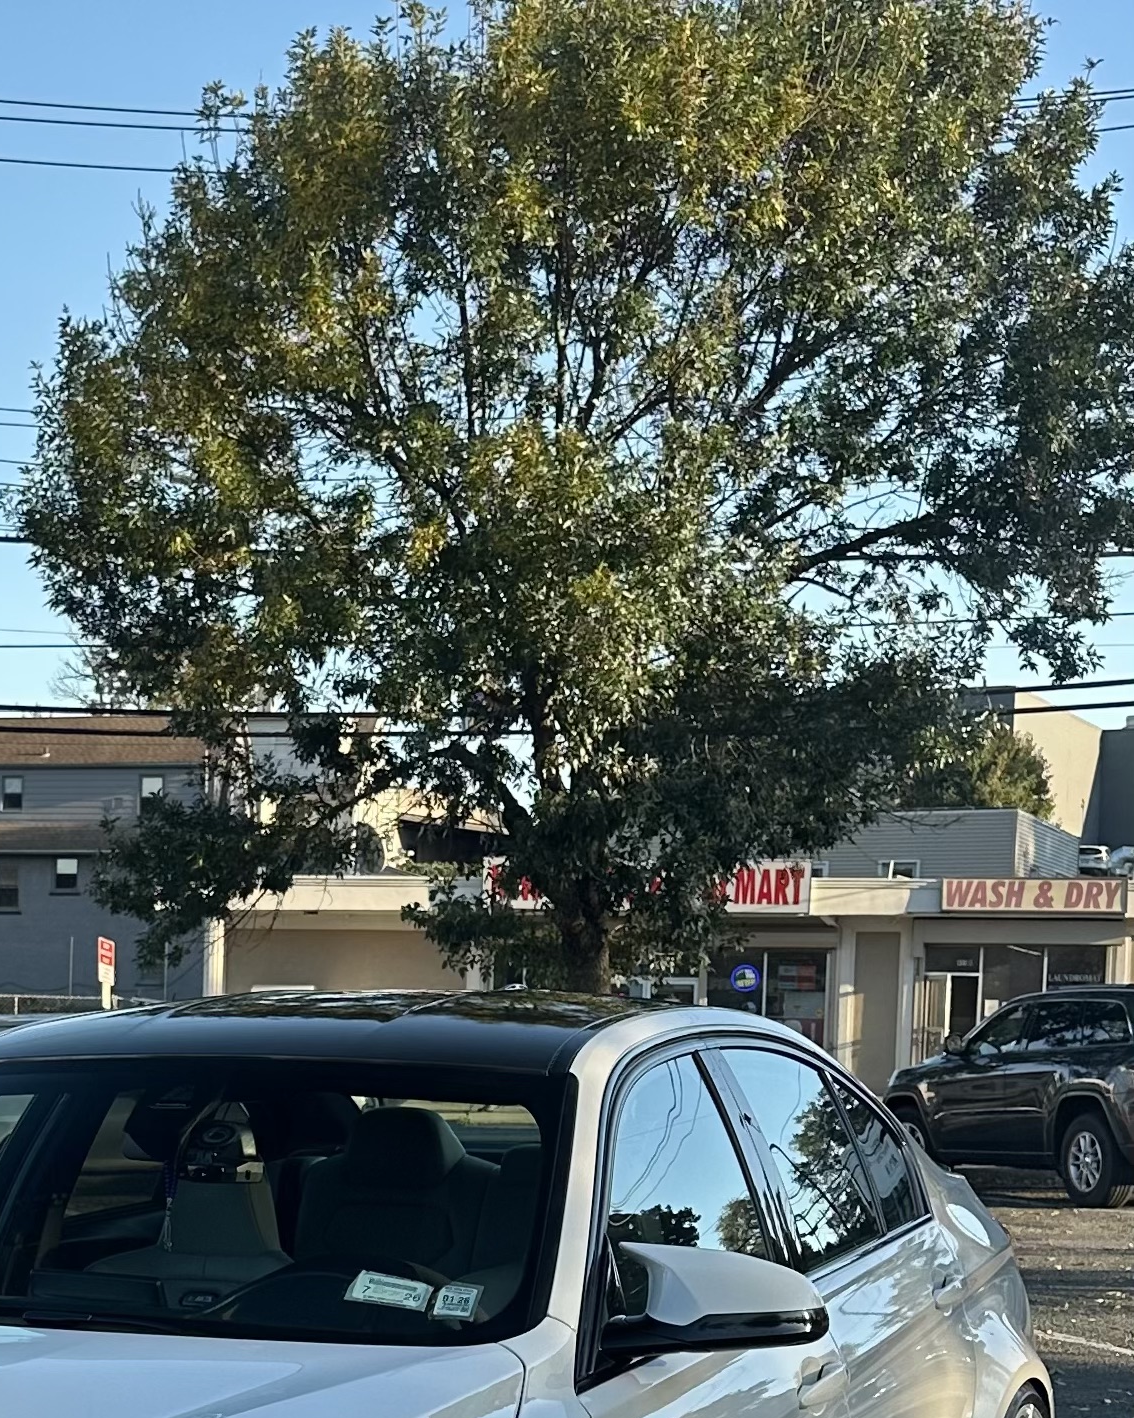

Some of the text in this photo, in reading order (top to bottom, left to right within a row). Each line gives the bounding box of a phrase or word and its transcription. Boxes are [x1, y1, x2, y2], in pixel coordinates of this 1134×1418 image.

[733, 868, 806, 905] MART
[946, 880, 1122, 910] WASH & DRY
